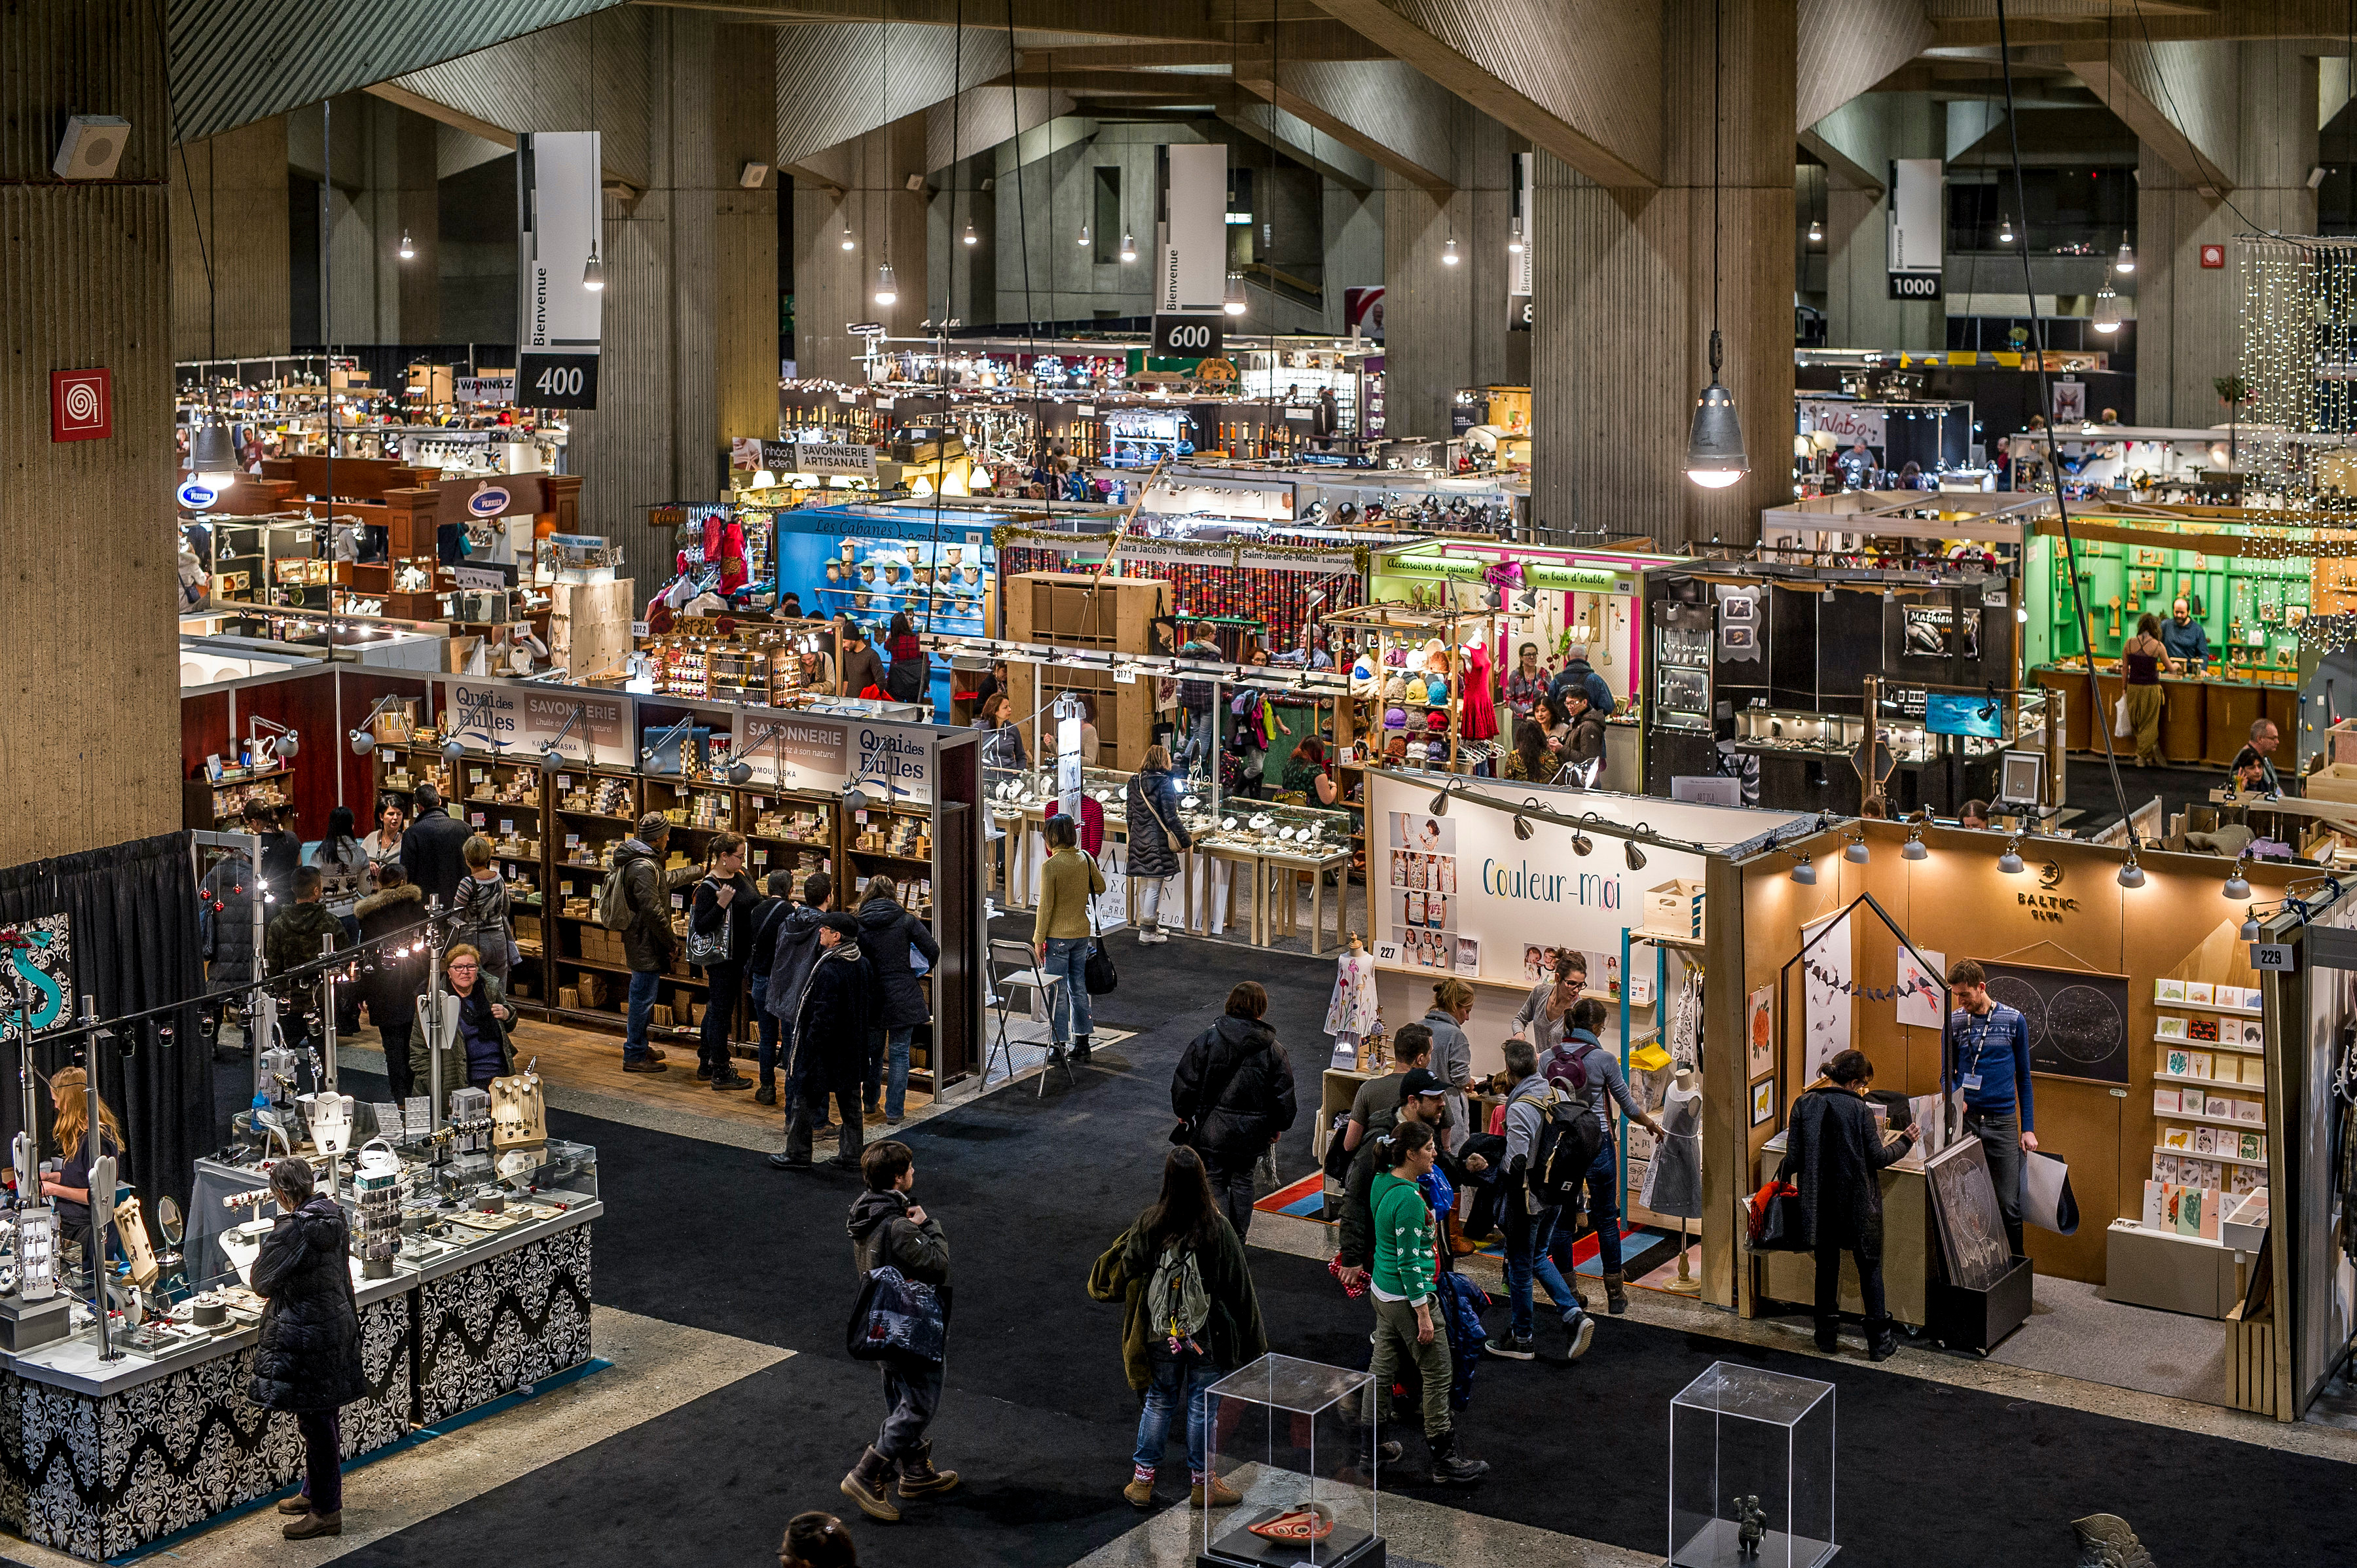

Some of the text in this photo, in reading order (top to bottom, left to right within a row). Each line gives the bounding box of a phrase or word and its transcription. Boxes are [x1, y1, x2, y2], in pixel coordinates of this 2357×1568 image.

[1522, 241, 1531, 291] Bienvenue
[1167, 250, 1178, 310] Bienvenue
[1894, 278, 1935, 295] 1000
[534, 267, 547, 346] Bienvenue
[1169, 326, 1210, 348] 600
[536, 367, 584, 395] 400
[802, 446, 868, 458] SAVONNERIE
[769, 459, 792, 469] eden
[804, 457, 869, 469] ARTISANALE
[481, 499, 503, 508] PERRIER
[815, 519, 835, 532] Les
[839, 520, 893, 536] Cabanes
[1139, 544, 1167, 555] Jacobs
[1175, 547, 1205, 557] Claude
[1207, 549, 1232, 558] Collin
[1242, 550, 1319, 562] Saint-Jean-de-Matha
[1387, 557, 1474, 574] Accessoires de cuisine
[1551, 571, 1569, 581] bois
[1571, 572, 1606, 585] d'érable
[1619, 583, 1630, 591] 423
[1910, 610, 1952, 624] Mathieu
[517, 625, 528, 634] 317.1
[633, 625, 646, 634] 317.2
[496, 695, 513, 710] des
[536, 718, 554, 727] L'huile
[812, 749, 837, 759] naturel
[904, 740, 924, 756] des
[916, 788, 928, 799] 221
[1483, 858, 1620, 909] Couleur-moi
[2018, 892, 2075, 909] BALTIC
[2031, 909, 2058, 919] CLUB
[1380, 946, 1395, 959] 227
[2261, 949, 2282, 965] 229
